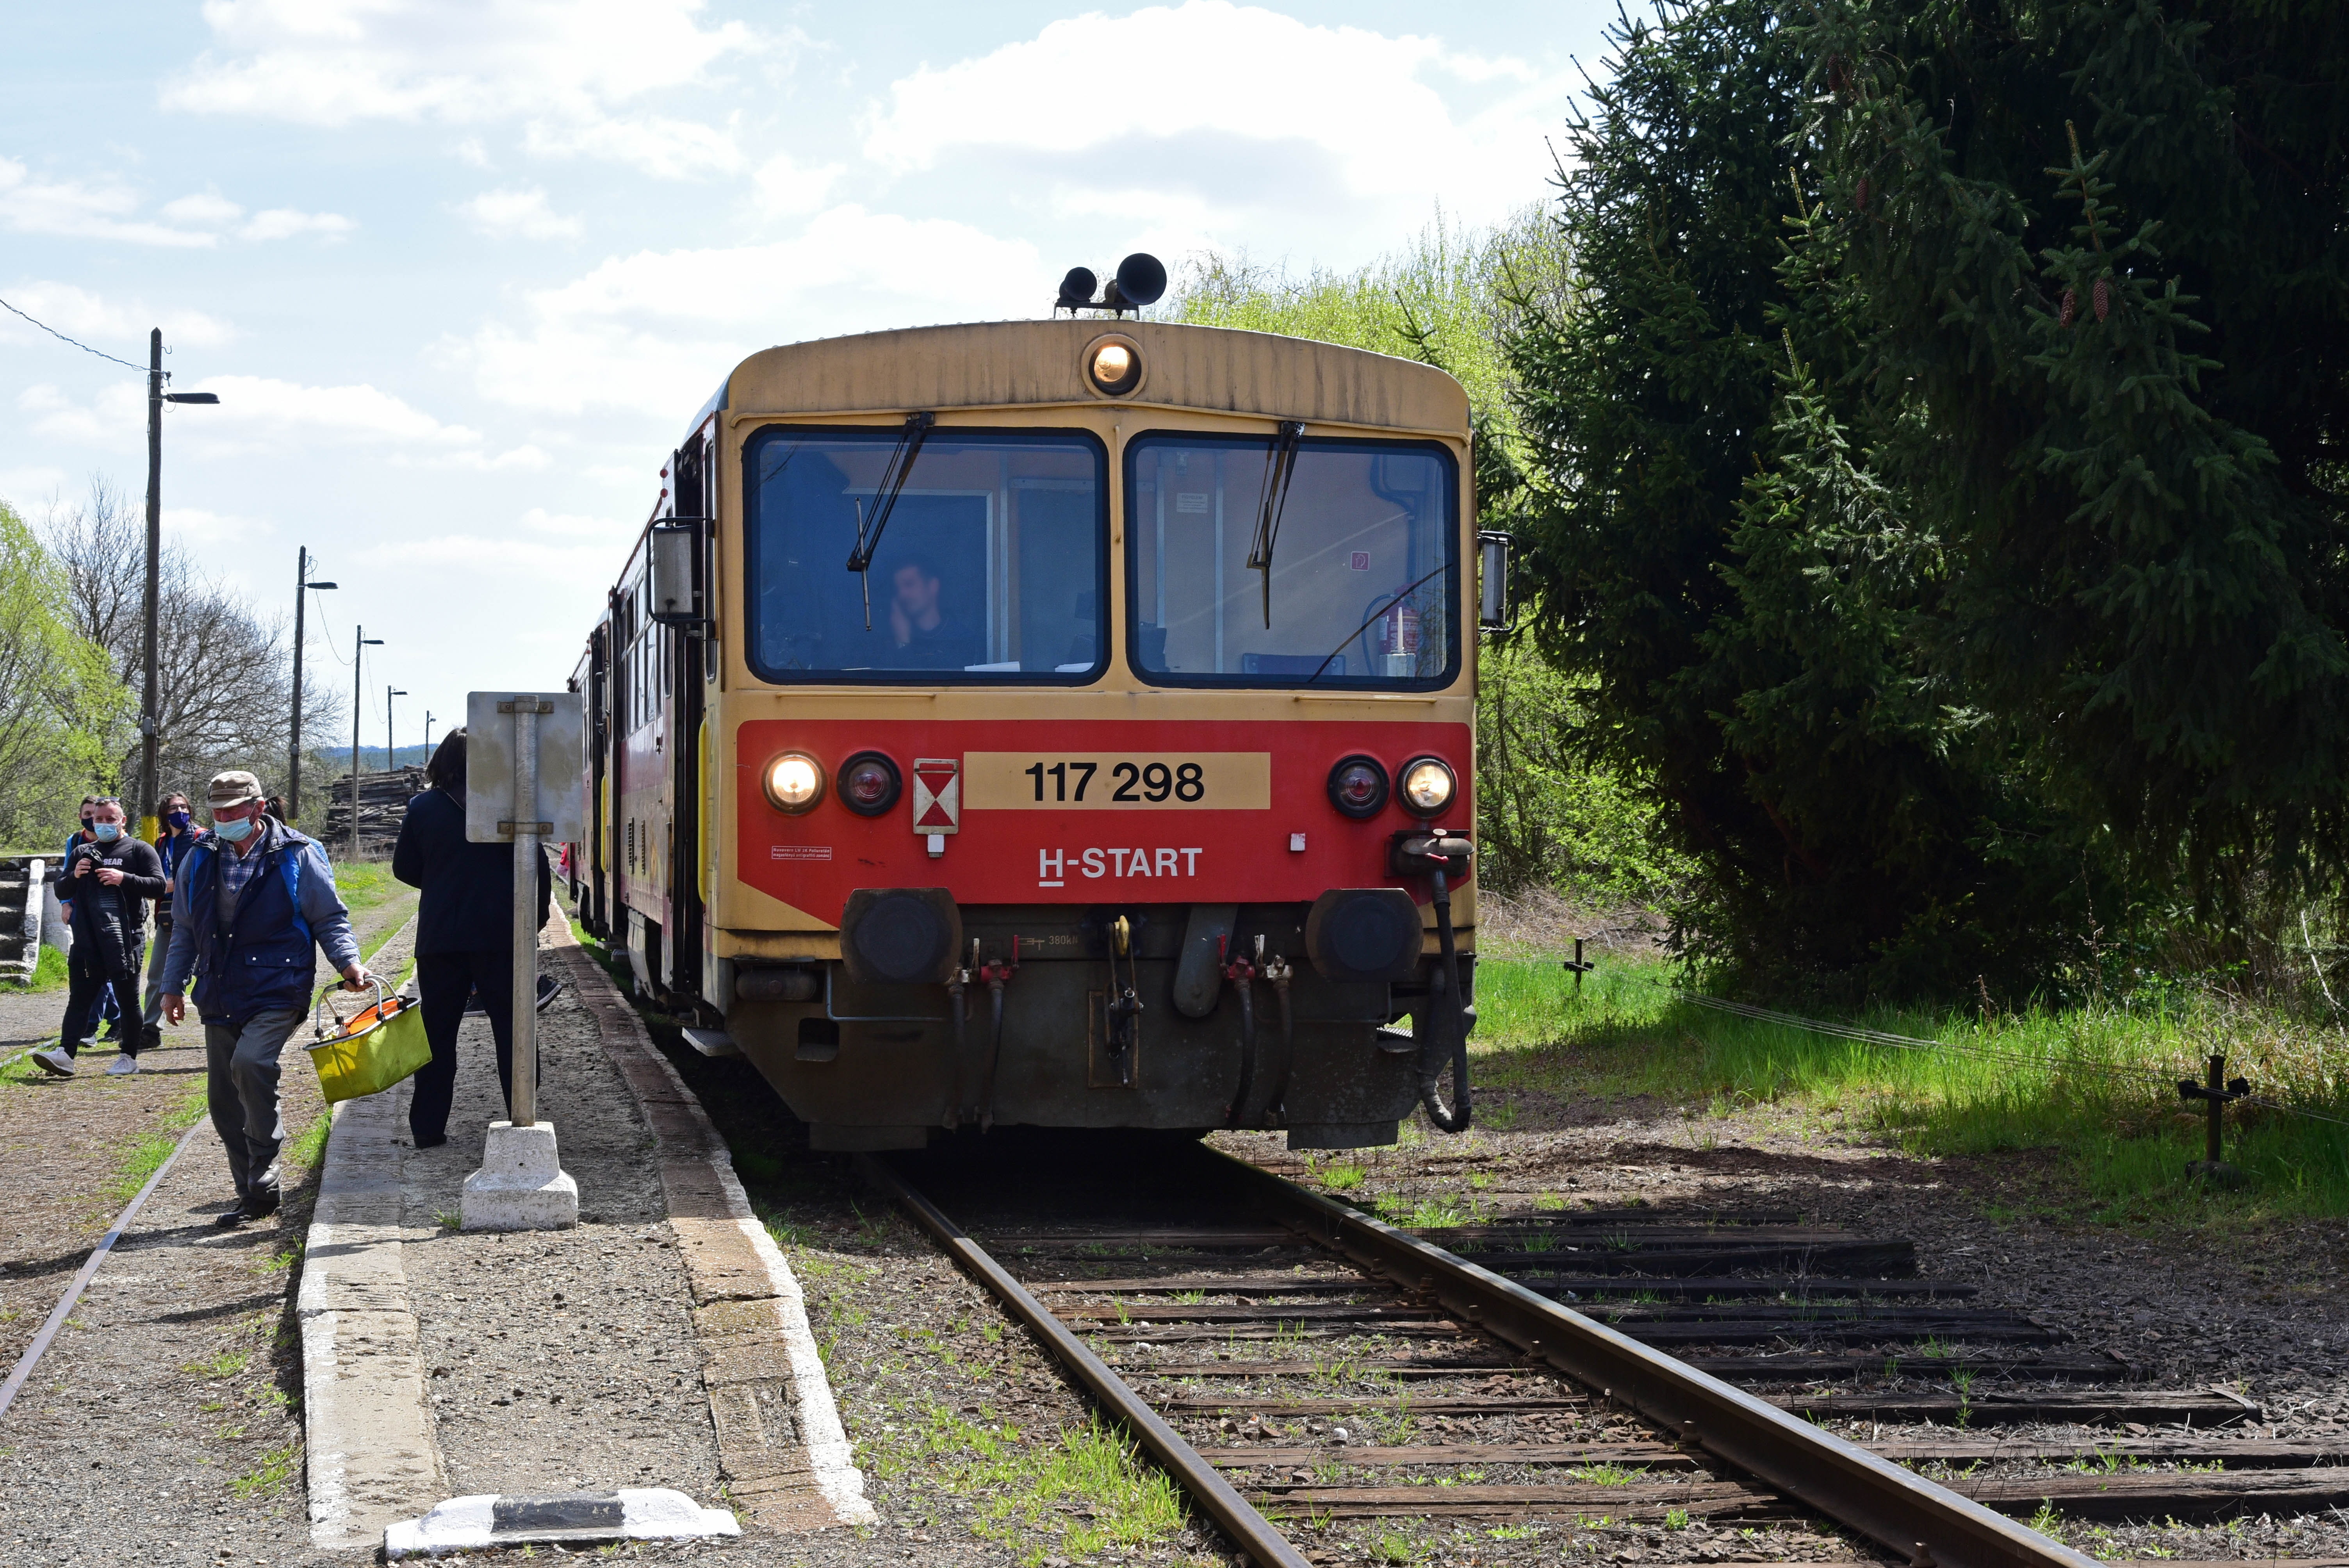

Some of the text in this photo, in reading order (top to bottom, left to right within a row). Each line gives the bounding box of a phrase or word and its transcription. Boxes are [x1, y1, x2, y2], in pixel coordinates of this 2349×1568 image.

[1025, 762, 1205, 802] 117 298
[1039, 848, 1203, 887] H-START
